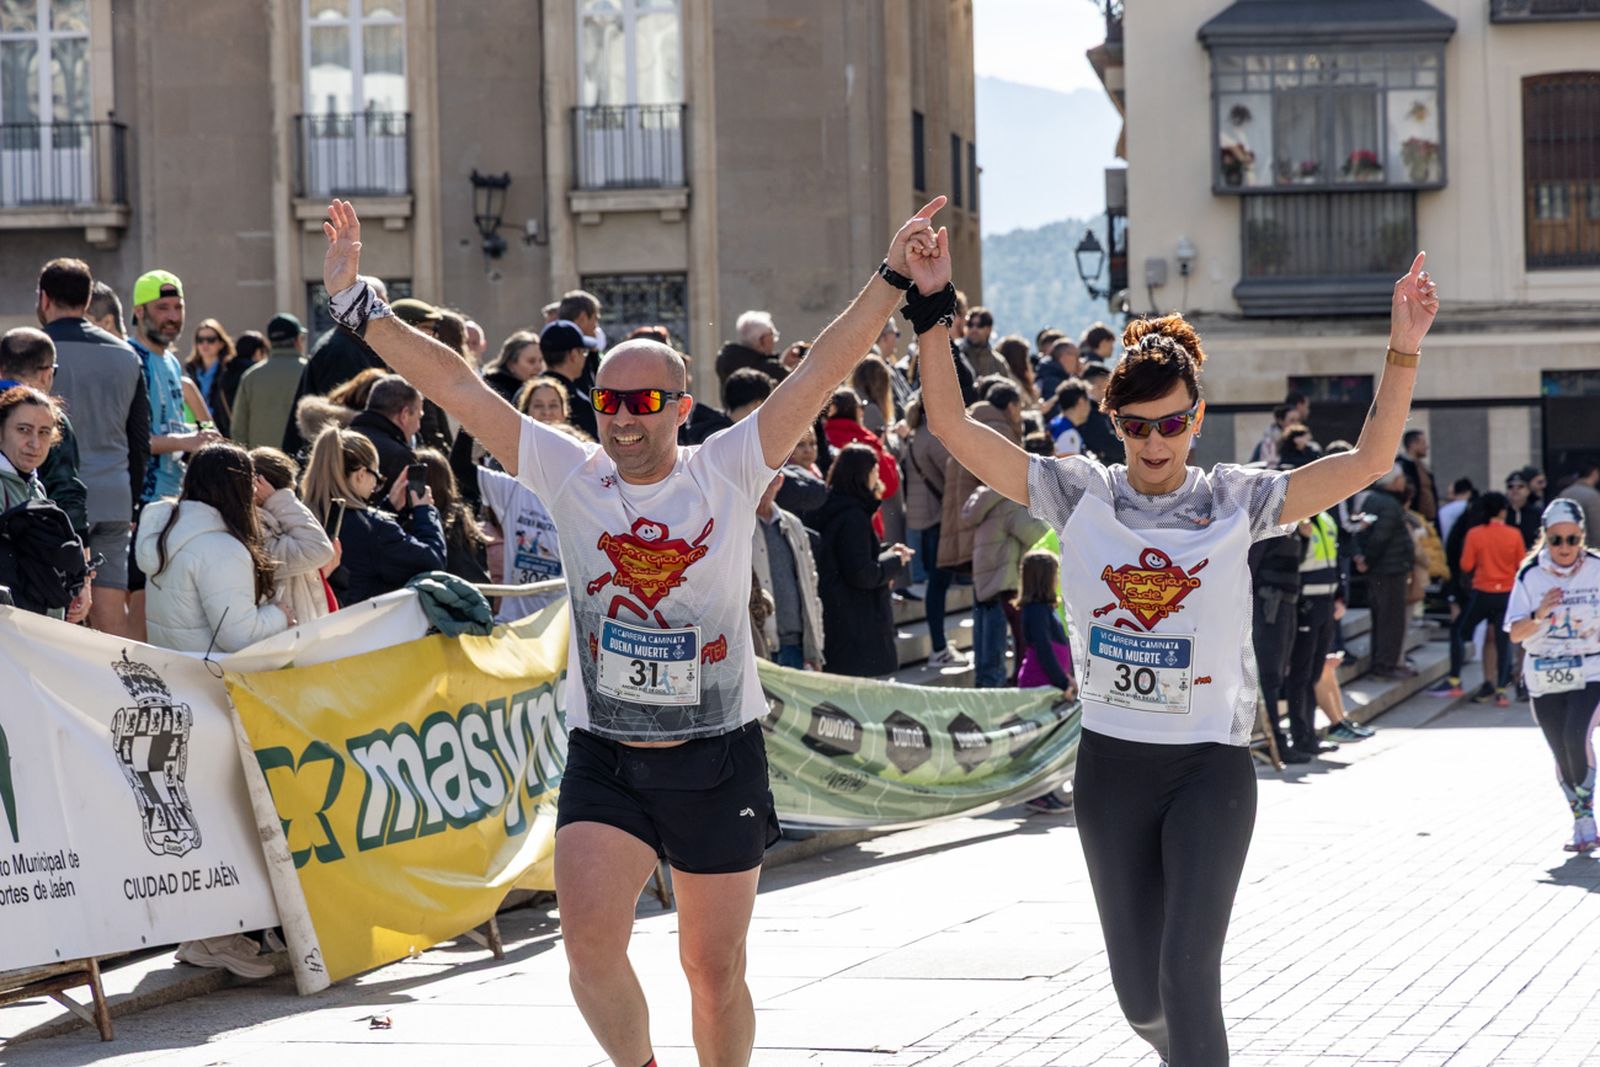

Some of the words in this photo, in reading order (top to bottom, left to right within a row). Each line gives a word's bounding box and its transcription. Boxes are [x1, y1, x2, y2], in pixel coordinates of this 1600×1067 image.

[1119, 600, 1184, 618] Asperger
[617, 629, 647, 642] CARRERA
[648, 636, 685, 645] CAMINATA
[1101, 631, 1107, 639] VI
[1108, 633, 1137, 647] CARRERA
[1140, 641, 1179, 650] CAMINATA
[610, 638, 632, 654] BUENA
[635, 645, 669, 659] MUERTE
[1098, 642, 1123, 659] BUENA
[1125, 650, 1161, 664] MUERTE
[629, 660, 658, 688] 31
[1114, 664, 1156, 695] 30
[1546, 669, 1574, 683] 506
[12, 849, 67, 876] Municipal
[69, 849, 80, 868] de
[33, 879, 48, 900] de
[49, 876, 76, 899] Jaén
[123, 873, 178, 900] CIUDAD
[182, 870, 201, 892] DE
[205, 861, 240, 889] JAÉN
